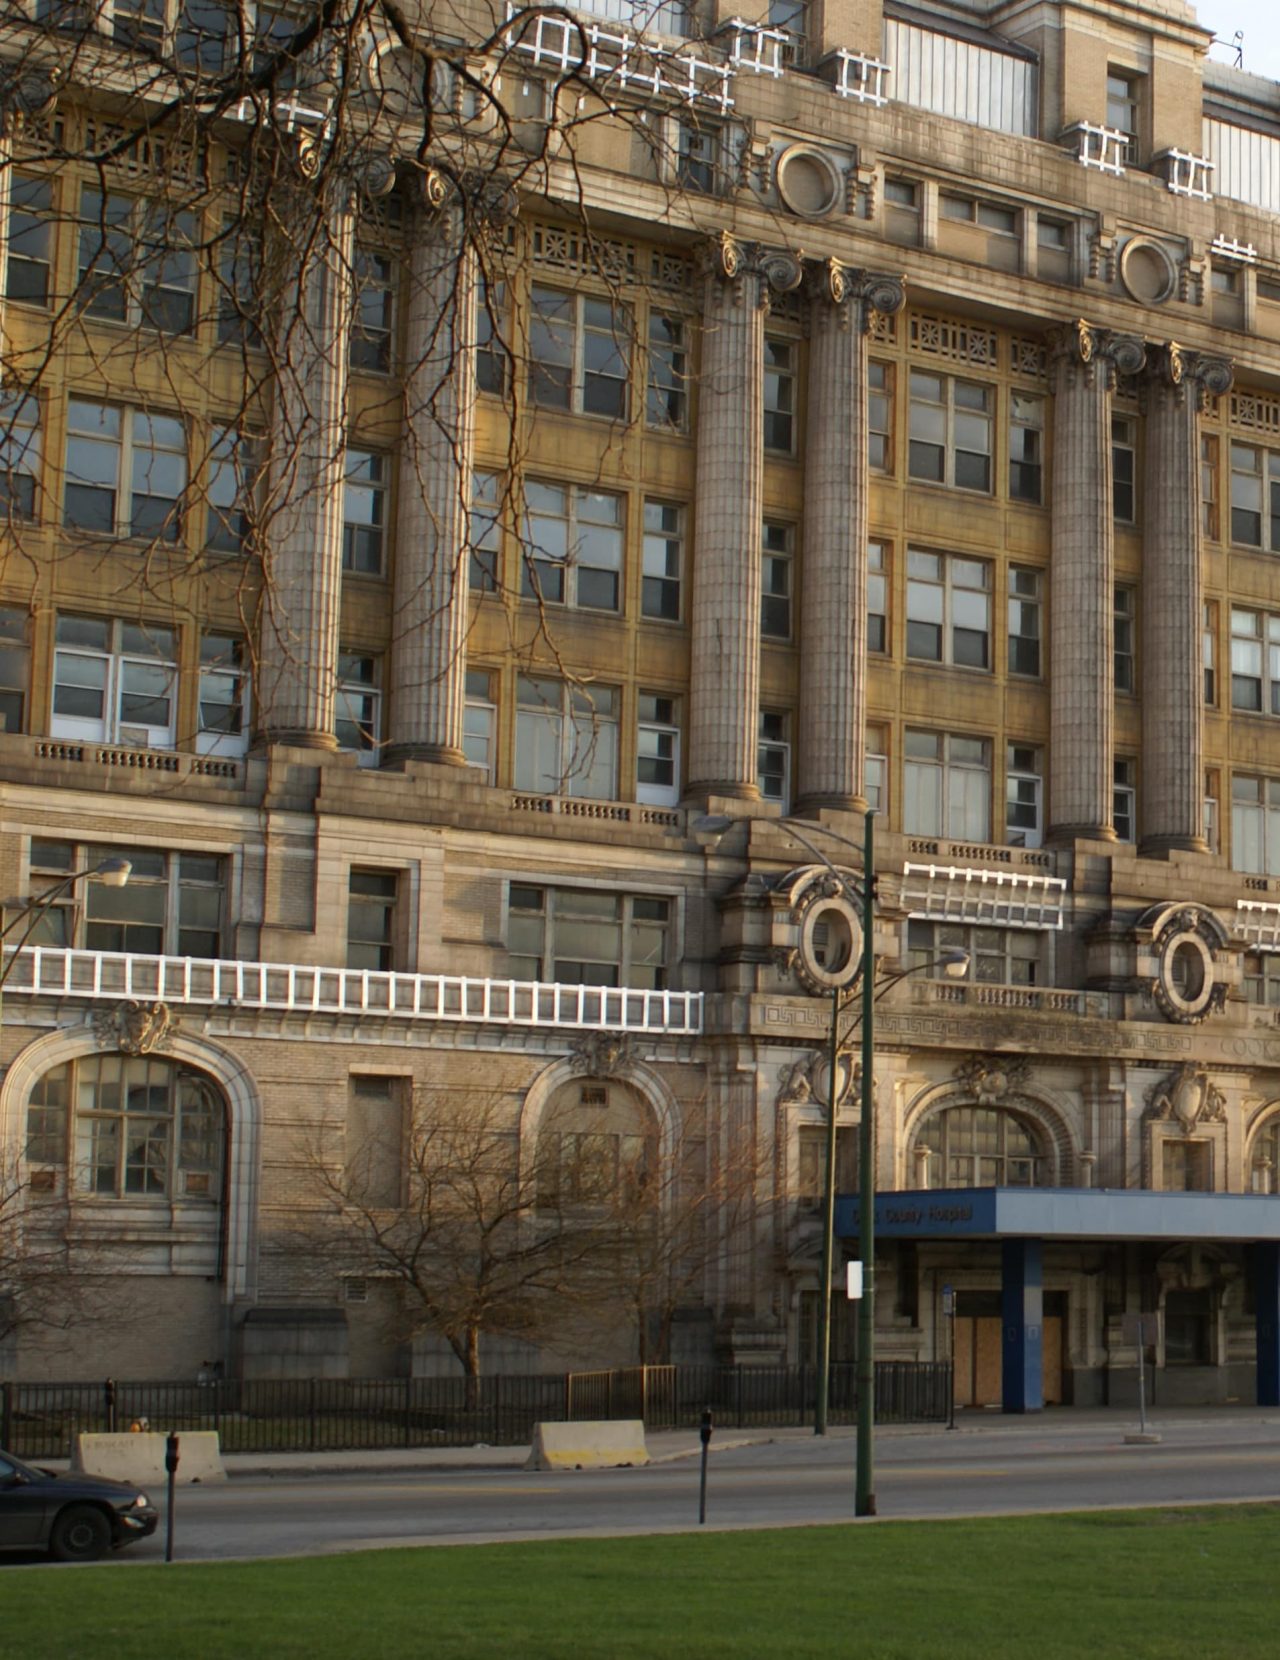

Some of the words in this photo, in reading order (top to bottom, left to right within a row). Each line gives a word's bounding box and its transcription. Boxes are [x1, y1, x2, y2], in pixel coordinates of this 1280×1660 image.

[1220, 1037, 1279, 1061] COOK
[886, 1208, 923, 1226] County
[928, 1204, 973, 1224] Hospital
